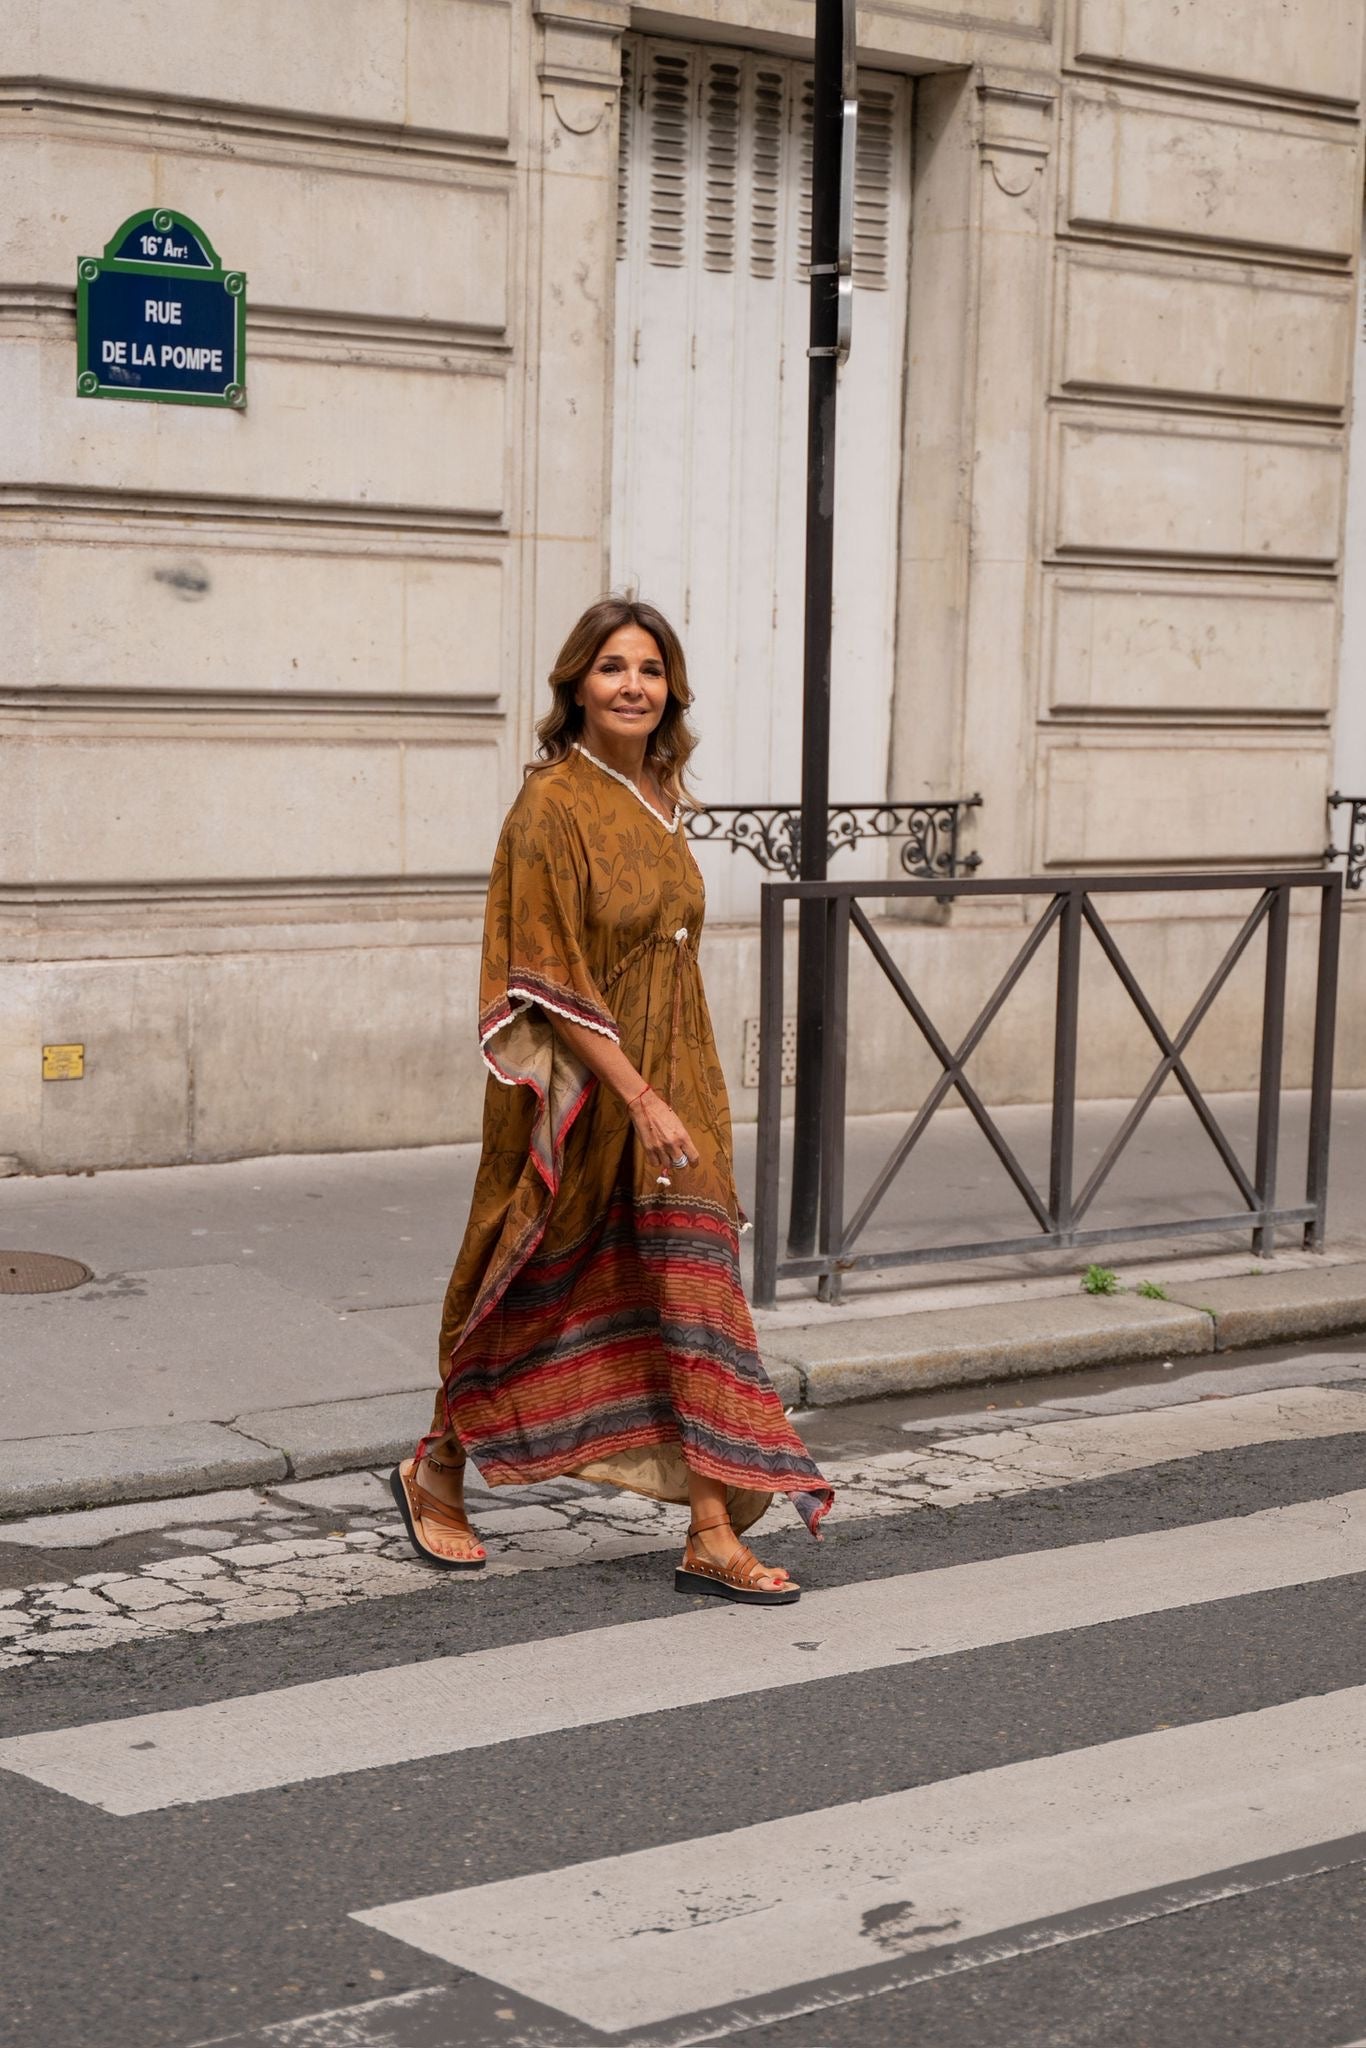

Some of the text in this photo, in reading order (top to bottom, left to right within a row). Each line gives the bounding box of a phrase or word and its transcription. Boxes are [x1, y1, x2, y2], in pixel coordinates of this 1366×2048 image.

[145, 300, 182, 325] RUE
[102, 340, 223, 372] DE LA POMPE
